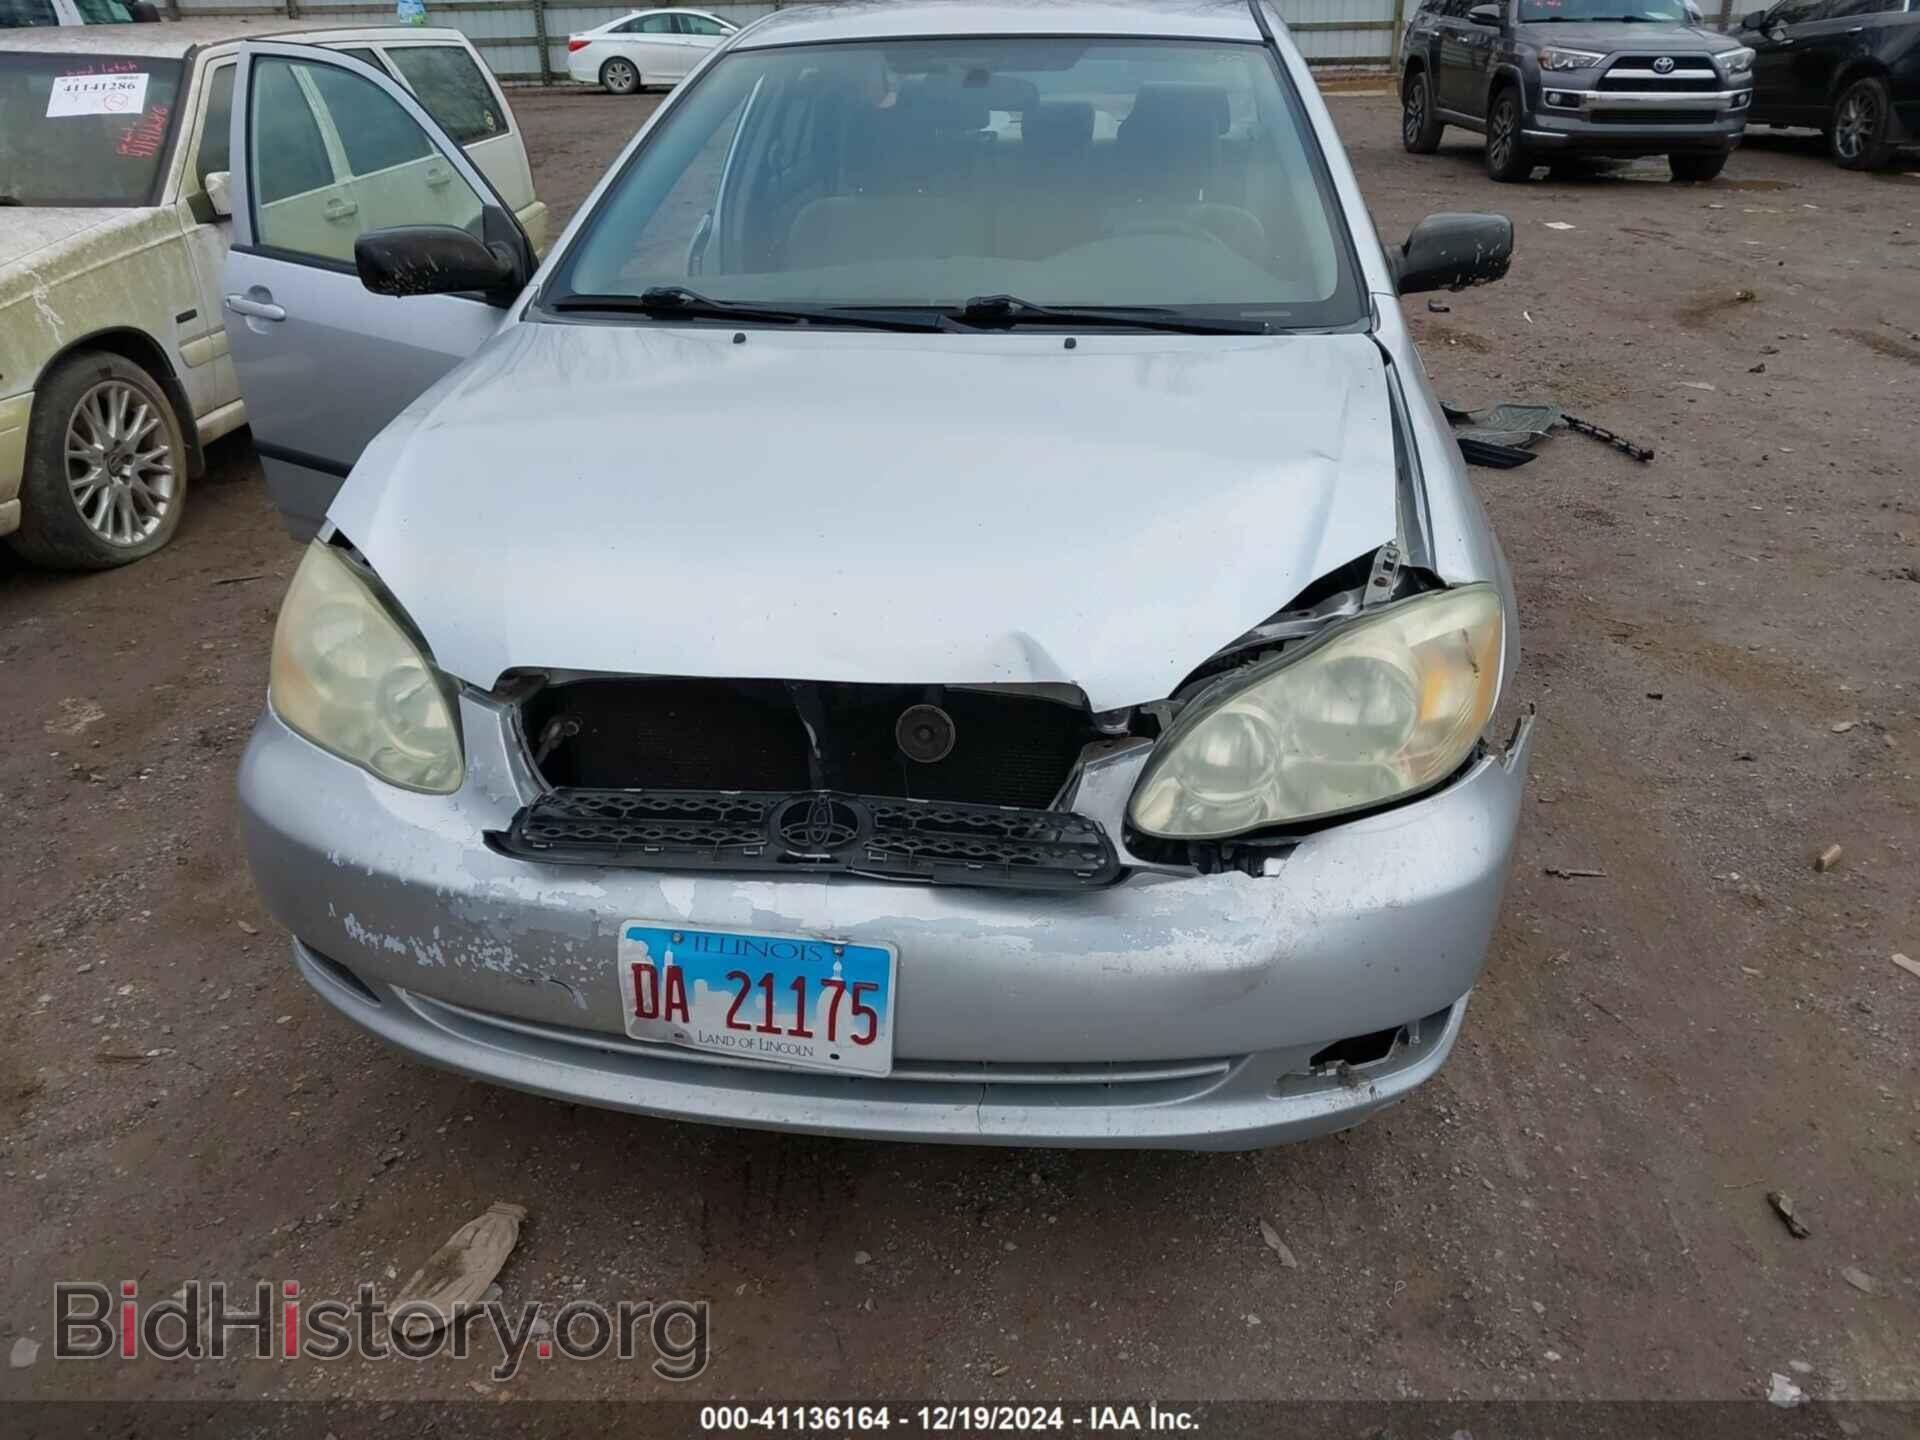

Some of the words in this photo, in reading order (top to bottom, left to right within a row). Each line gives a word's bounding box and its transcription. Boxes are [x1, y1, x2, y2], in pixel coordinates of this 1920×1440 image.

[64, 82, 136, 92] 41141286
[694, 935, 824, 962] ILLINOIS
[631, 962, 690, 1024] DA
[725, 969, 880, 1046] 21175
